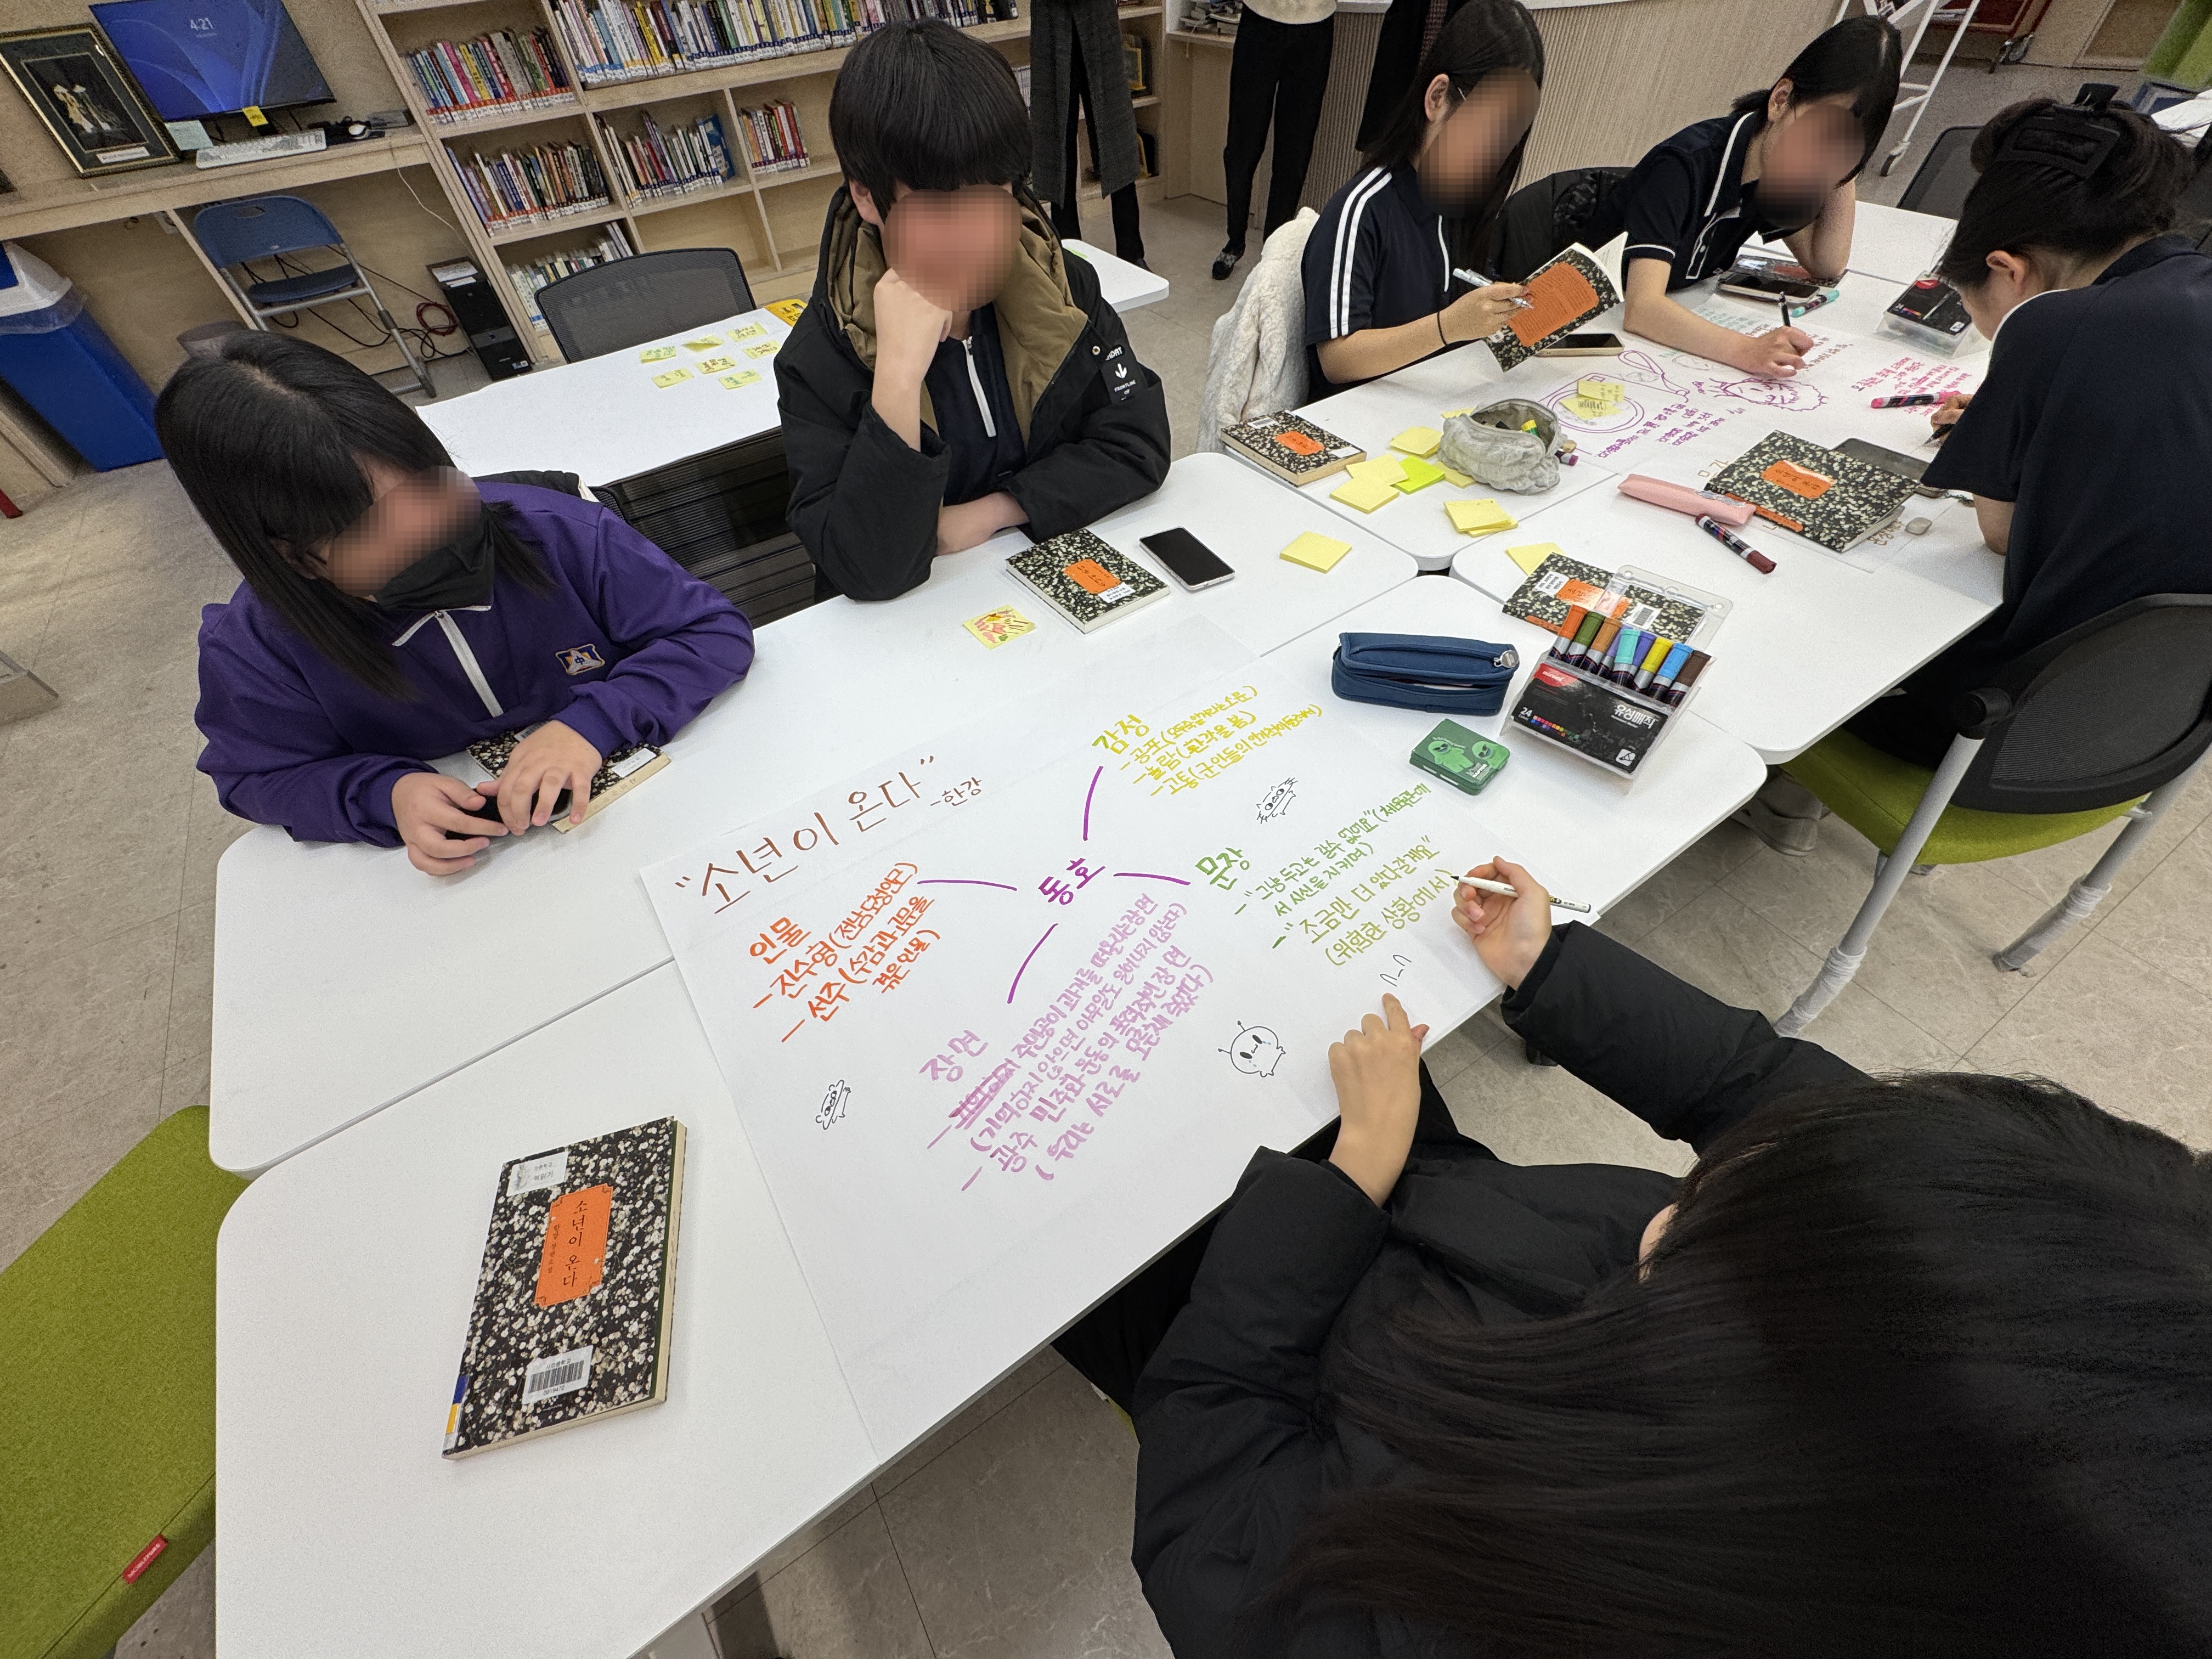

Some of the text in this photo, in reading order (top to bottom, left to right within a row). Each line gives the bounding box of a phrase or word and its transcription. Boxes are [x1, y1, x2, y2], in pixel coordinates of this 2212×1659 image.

[1520, 707, 1533, 717] 24
[1614, 704, 1656, 730] 유성매직
[1092, 714, 1150, 755] 감정
[1039, 857, 1106, 905] 동호
[1195, 848, 1250, 890] 문장
[1351, 883, 1376, 902] 더
[749, 917, 811, 964] 인물
[919, 1030, 989, 1082] 장면
[1086, 1065, 1141, 1117] 서로를
[989, 1132, 1038, 1172] 광주
[562, 1199, 588, 1288] 소년이 온다
